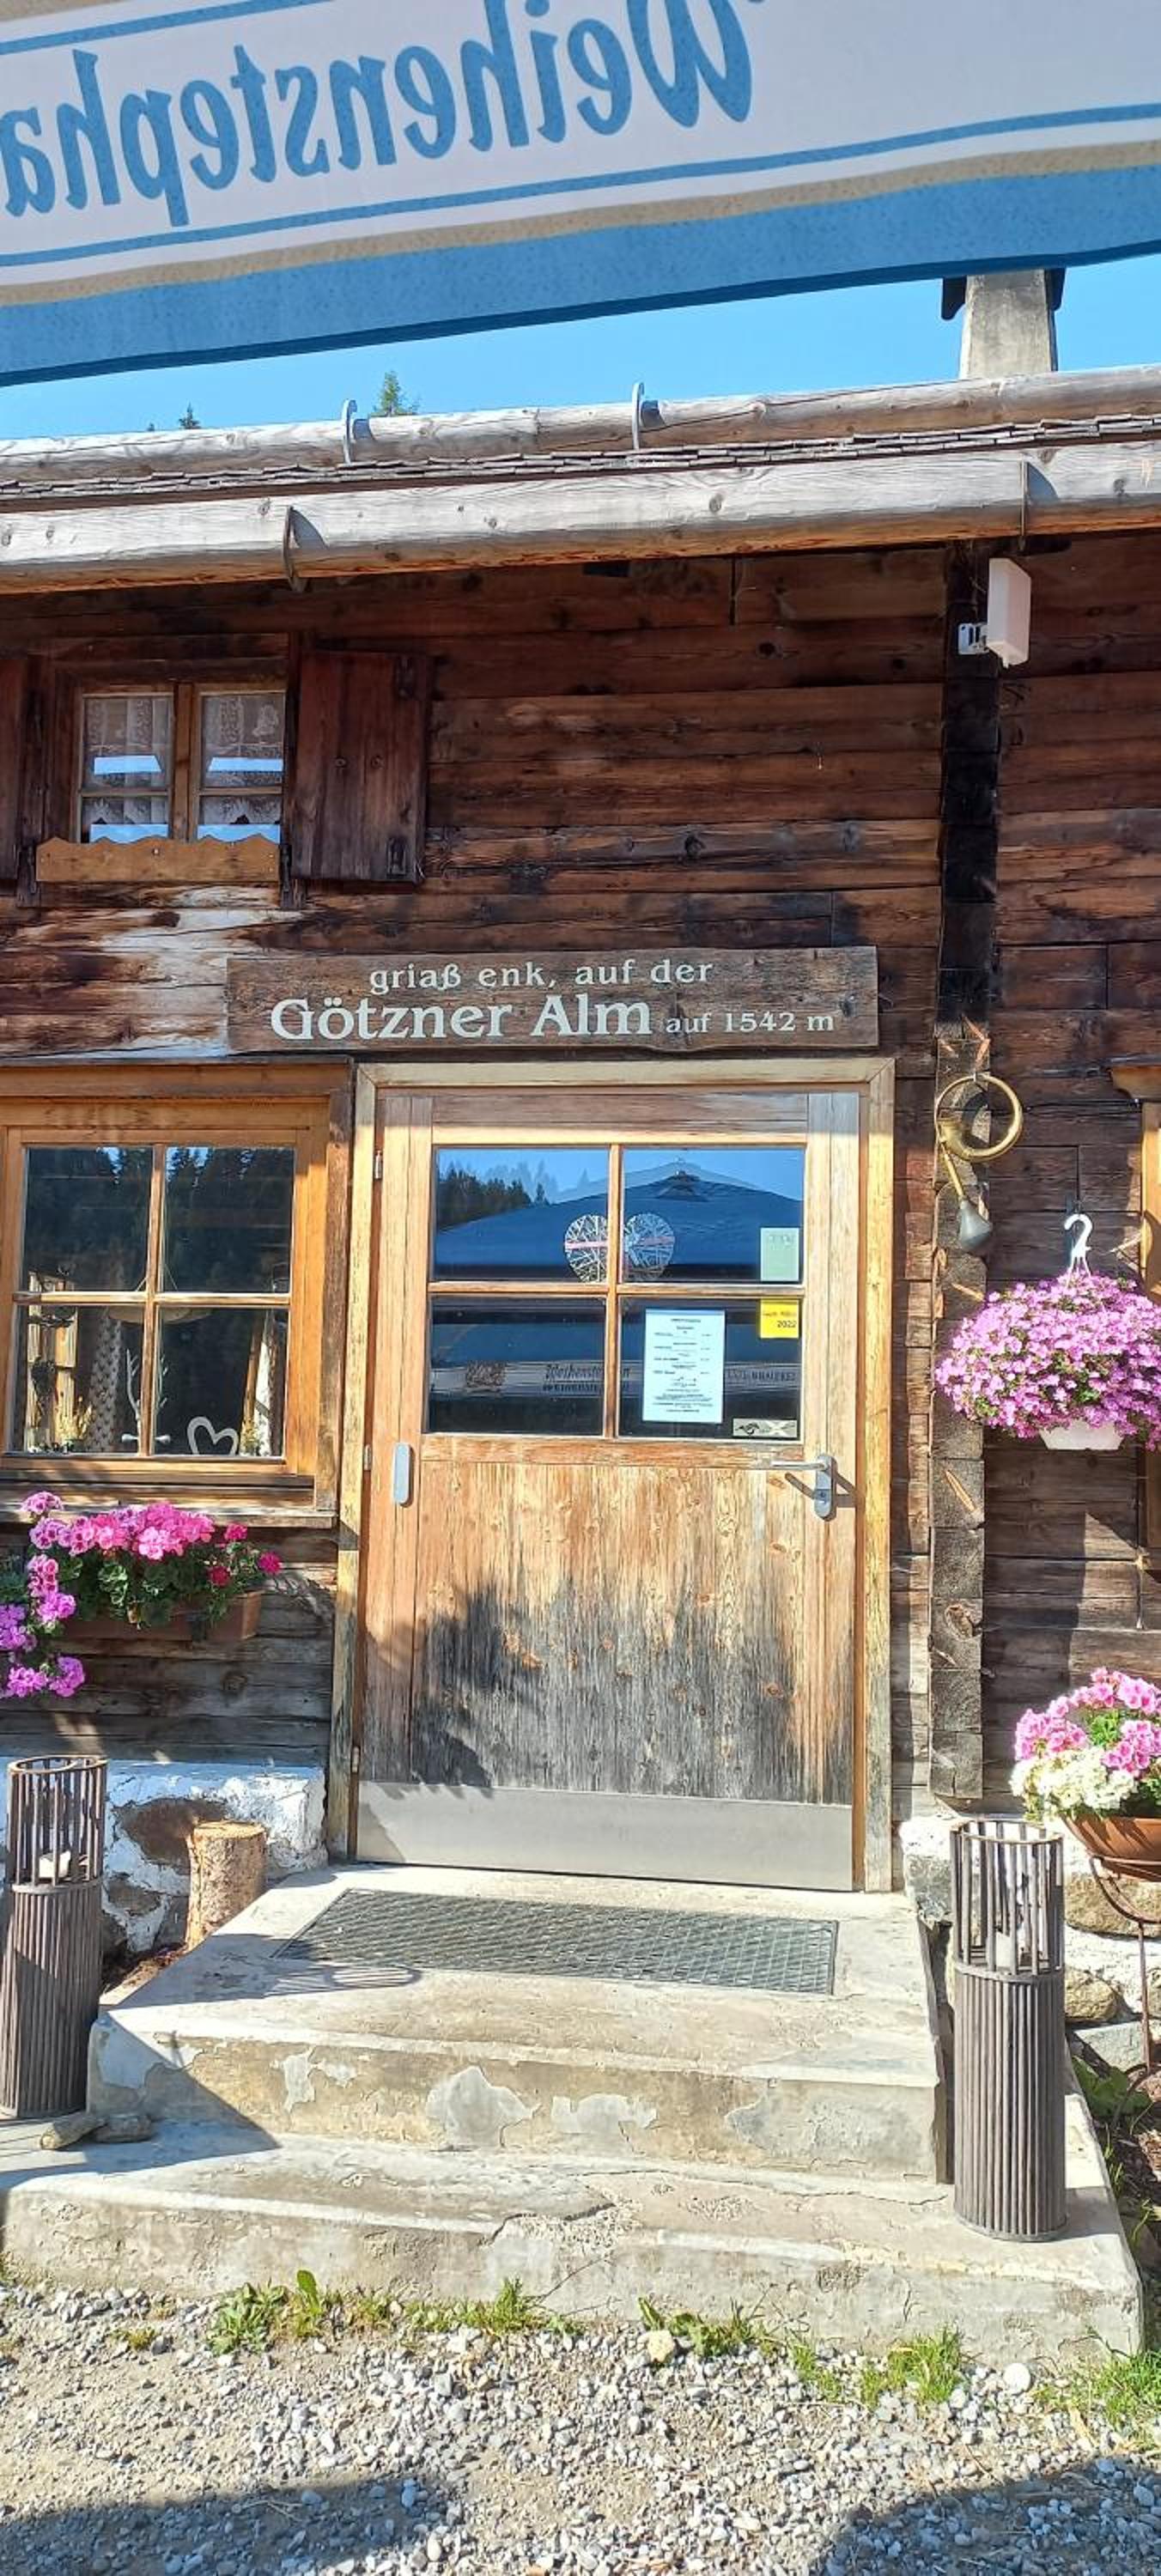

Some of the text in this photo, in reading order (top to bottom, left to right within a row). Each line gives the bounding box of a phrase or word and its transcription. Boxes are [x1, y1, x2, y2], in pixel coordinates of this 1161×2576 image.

[369, 958, 714, 995] griaß enk, auf der
[270, 993, 835, 1041] Götzner Alm auf 1542 m
